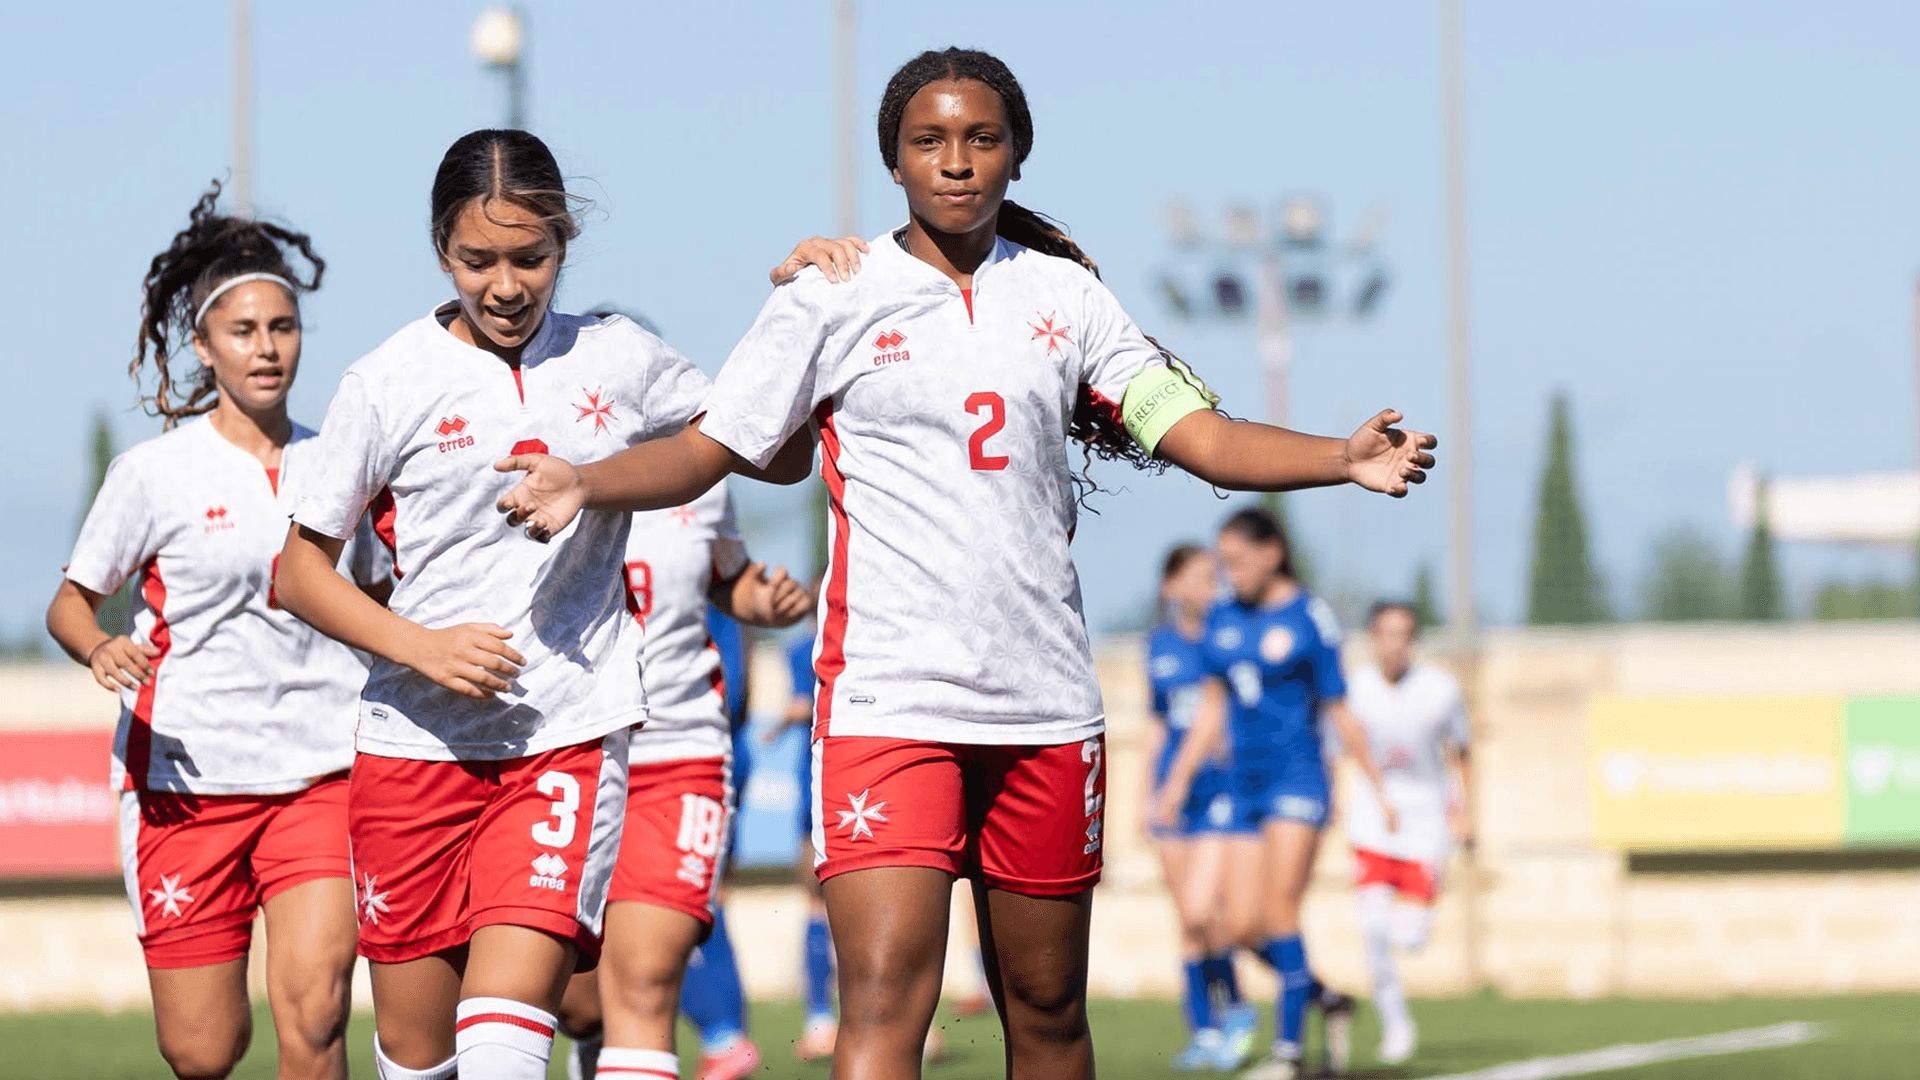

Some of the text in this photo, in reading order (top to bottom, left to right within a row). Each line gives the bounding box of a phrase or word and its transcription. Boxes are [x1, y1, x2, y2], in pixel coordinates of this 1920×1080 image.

[873, 350, 910, 366] errea
[1134, 382, 1181, 422] RESPECT
[438, 435, 475, 453] errea
[964, 391, 1010, 471] 2
[1081, 736, 1103, 818] 2
[531, 770, 581, 849] 3
[676, 793, 722, 857] 18
[529, 875, 566, 891] errea
